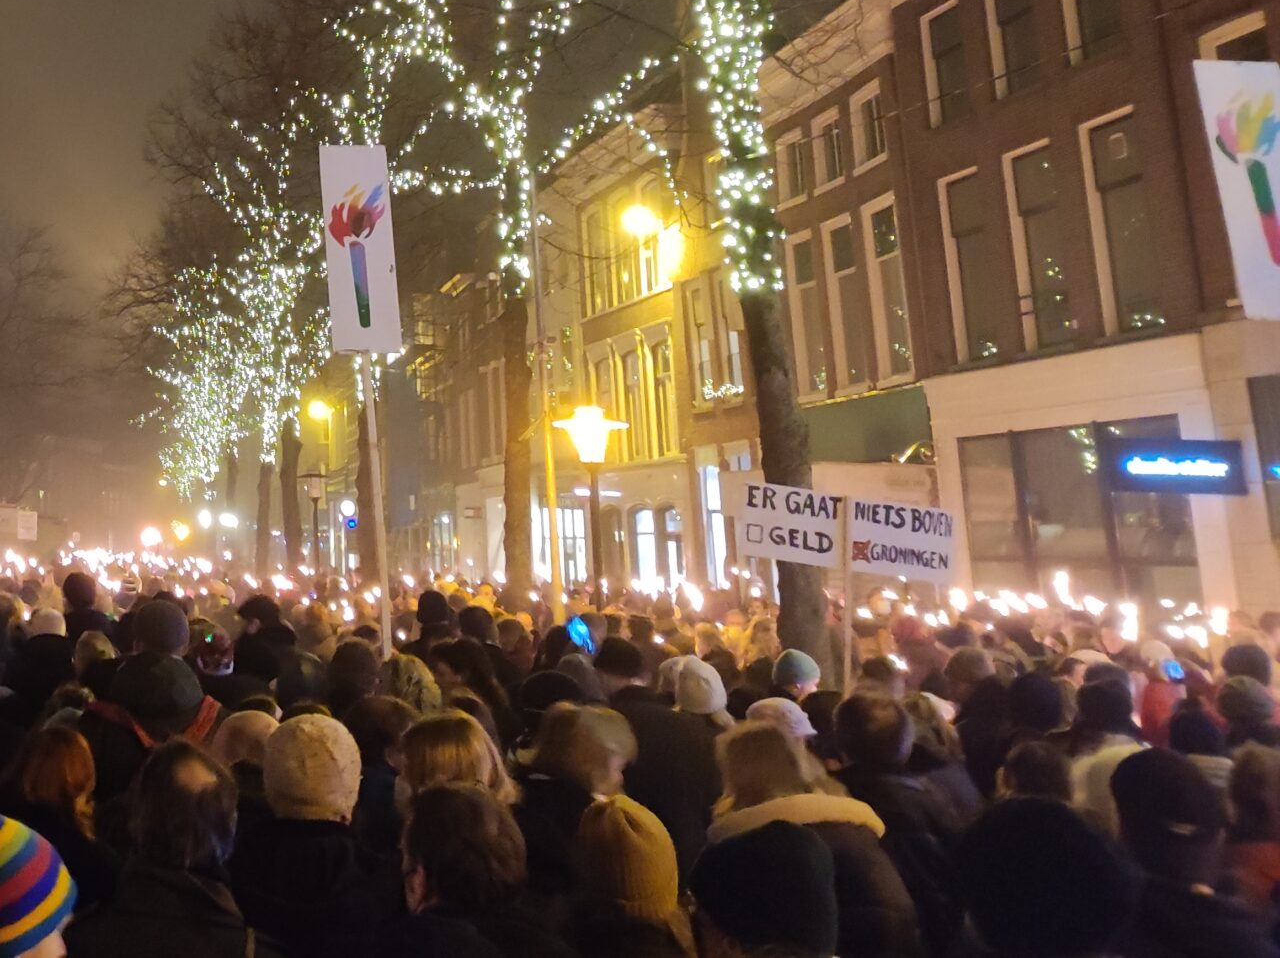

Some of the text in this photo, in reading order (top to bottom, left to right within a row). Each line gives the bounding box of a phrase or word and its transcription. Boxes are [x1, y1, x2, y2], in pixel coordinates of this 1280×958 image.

[746, 485, 953, 538] ER GAAT NIETS BOVEN
[768, 526, 834, 554] GELD
[870, 542, 950, 570] GRONINGEN
